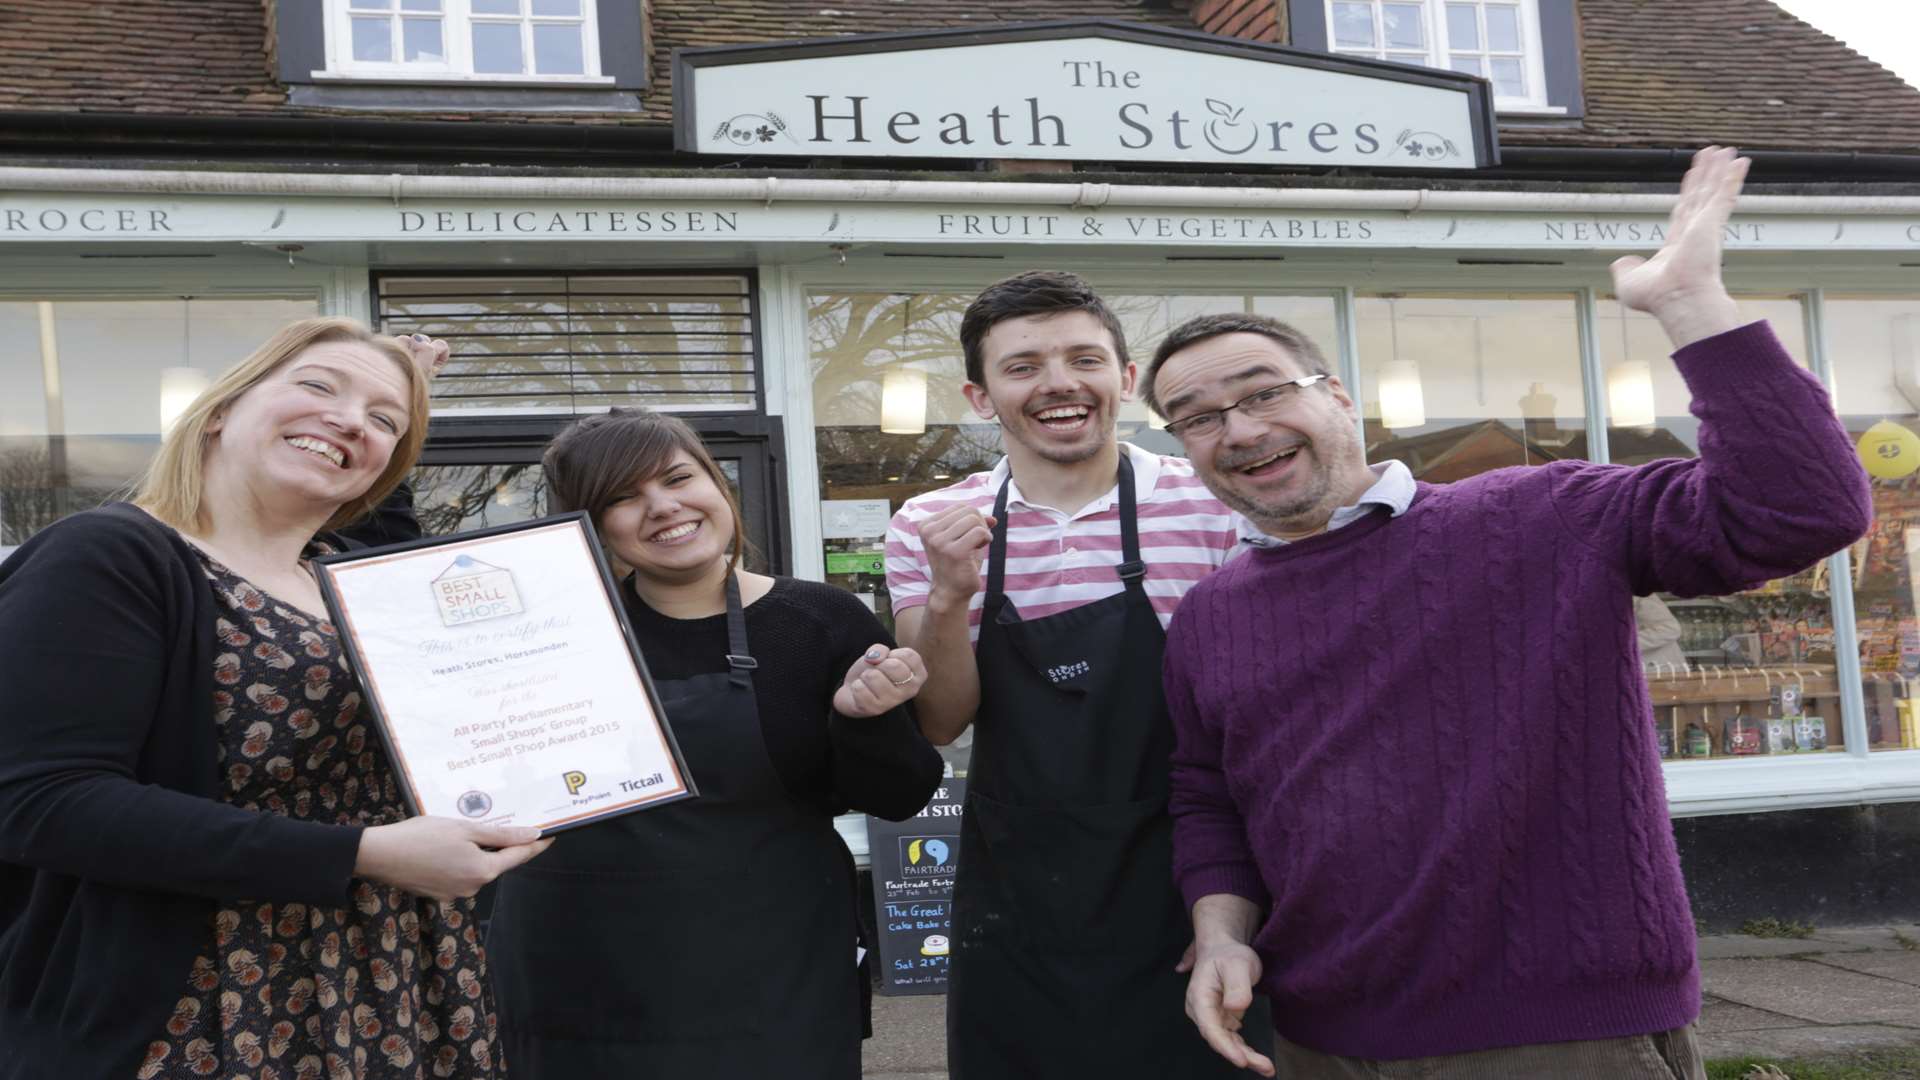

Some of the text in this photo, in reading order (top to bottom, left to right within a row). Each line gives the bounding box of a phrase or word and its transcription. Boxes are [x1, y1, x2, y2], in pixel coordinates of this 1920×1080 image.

[1062, 60, 1141, 89] The
[805, 95, 1380, 155] Heath Stores
[4, 208, 173, 233] ROCER
[400, 210, 738, 233] DELICATESSEN
[937, 213, 1374, 241] FRUIT & VEGETABLES
[1543, 222, 1766, 241] NEWSANT
[441, 576, 482, 595] BEST
[445, 588, 505, 608] SMALL
[449, 602, 512, 622] SHOPS
[432, 664, 464, 676] Heath
[504, 641, 569, 660] Horsmonden
[1048, 661, 1088, 678] Stores
[453, 698, 593, 738] All Party Parliamentary
[470, 734, 505, 750] Small
[550, 714, 588, 730] Group
[446, 720, 621, 771] Best Small Shop Award 2015
[619, 773, 665, 792] Tictail
[572, 791, 612, 805] PayPoint
[884, 905, 908, 918] The
[910, 905, 944, 918] Great
[888, 921, 913, 931] Cake
[916, 920, 940, 929] Bake
[895, 958, 914, 970] Sat
